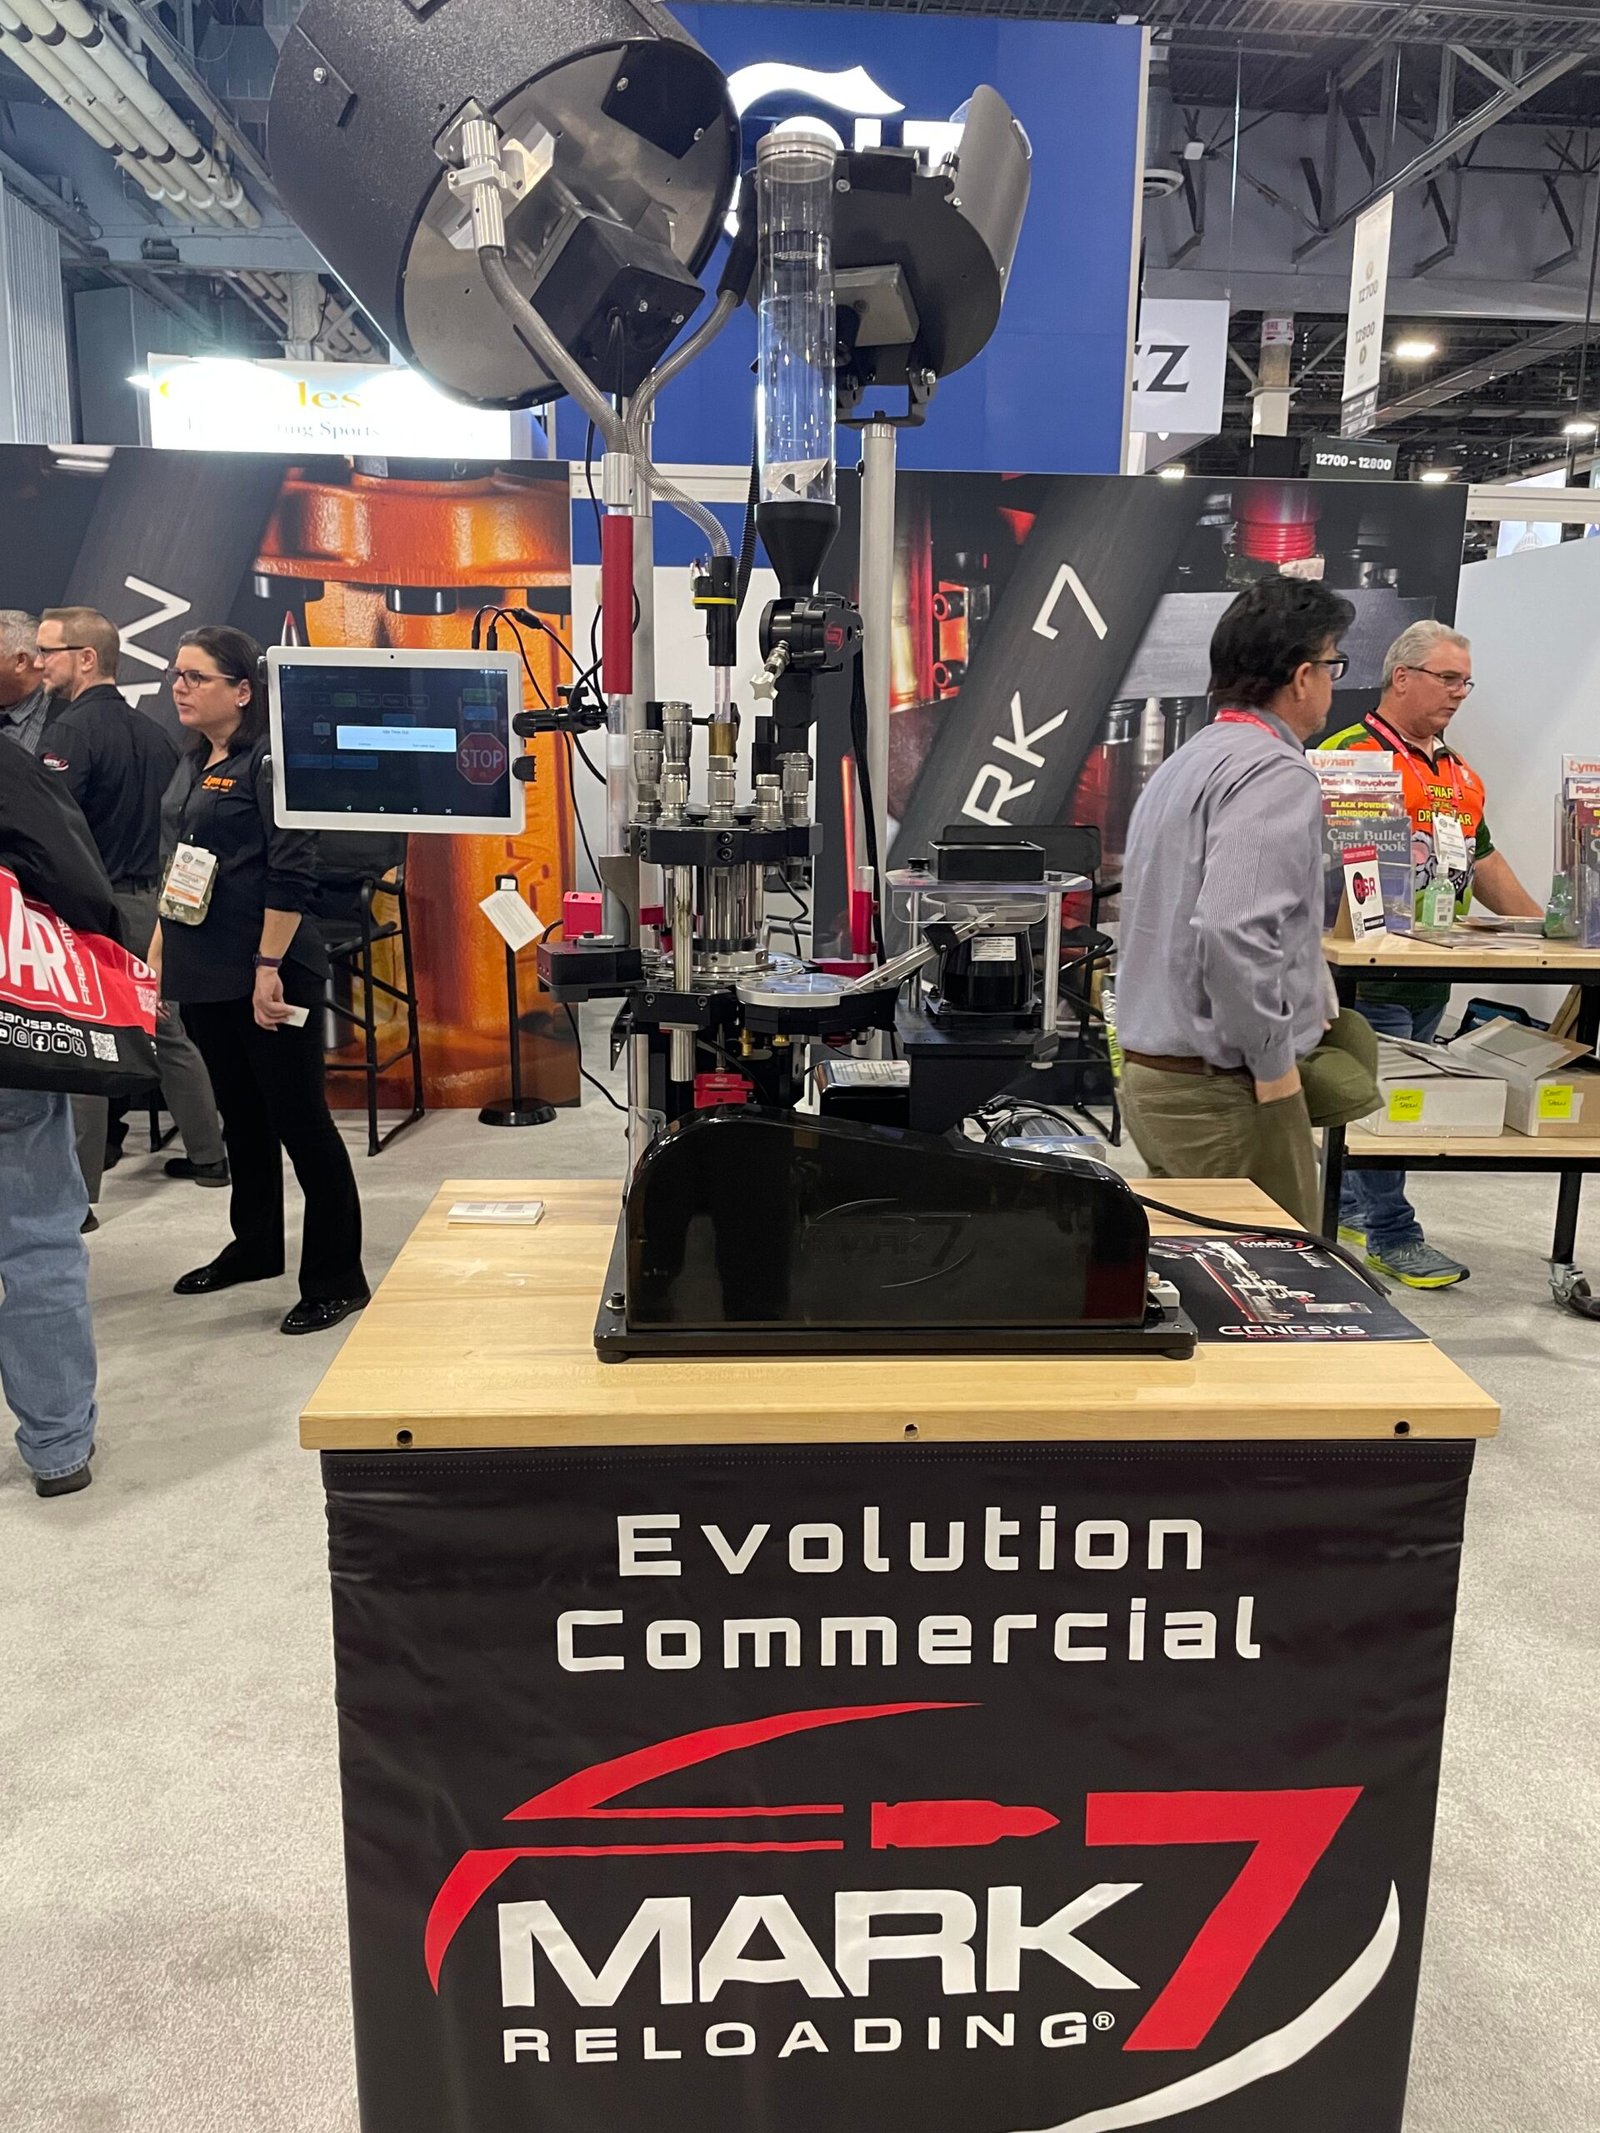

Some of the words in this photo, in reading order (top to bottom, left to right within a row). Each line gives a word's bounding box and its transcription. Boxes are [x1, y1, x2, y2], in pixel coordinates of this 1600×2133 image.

[1132, 344, 1190, 393] Z
[1315, 453, 1349, 467] 12700
[1358, 457, 1392, 471] 12800
[460, 749, 504, 769] STOP
[962, 690, 1069, 826] RK
[1312, 756, 1355, 768] Lyman
[1355, 779, 1398, 788] Revolver
[1331, 801, 1357, 809] BLACK
[1327, 828, 1359, 841] Cast
[1363, 829, 1407, 842] Bullet
[0, 886, 78, 1004] AR
[616, 1505, 1203, 1577] Evolution
[556, 1595, 1262, 1673] Commercial
[497, 1882, 1143, 2008] MARK
[1085, 1785, 1364, 2051] 7
